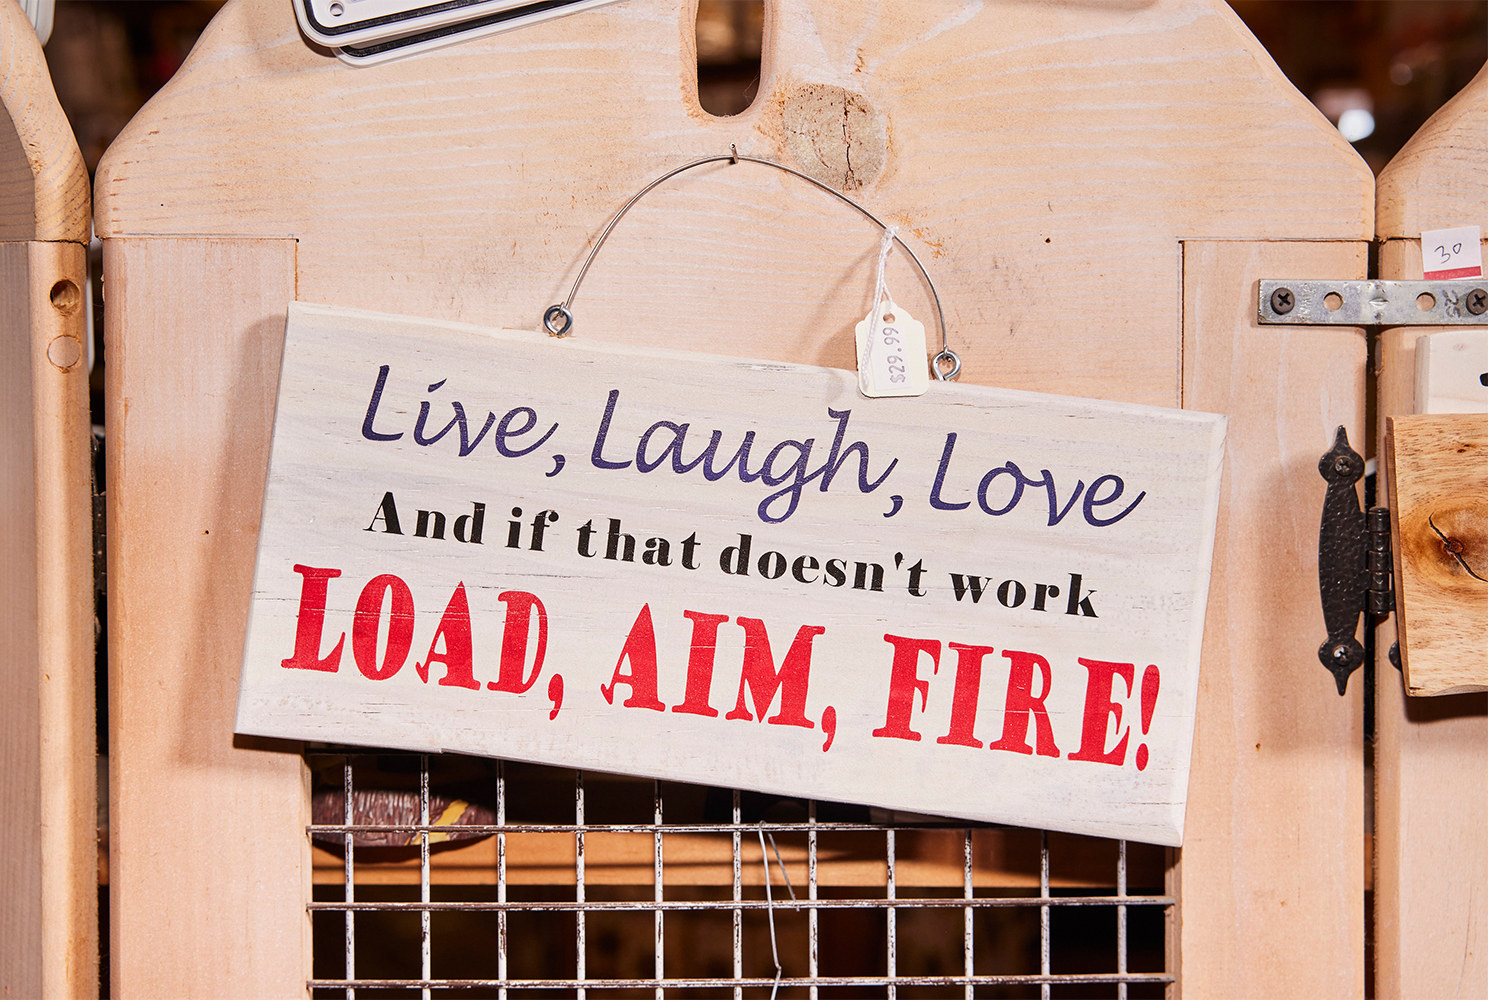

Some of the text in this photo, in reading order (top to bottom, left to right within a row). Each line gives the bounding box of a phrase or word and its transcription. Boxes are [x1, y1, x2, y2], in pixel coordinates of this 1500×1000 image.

[1434, 242, 1462, 264] 30
[882, 327, 906, 383] $29.99
[361, 364, 1147, 527] Live, Laugh, Love
[362, 491, 1099, 619] And if that doesn't work
[280, 563, 1162, 772] LOAD, AIM, FIRE!
